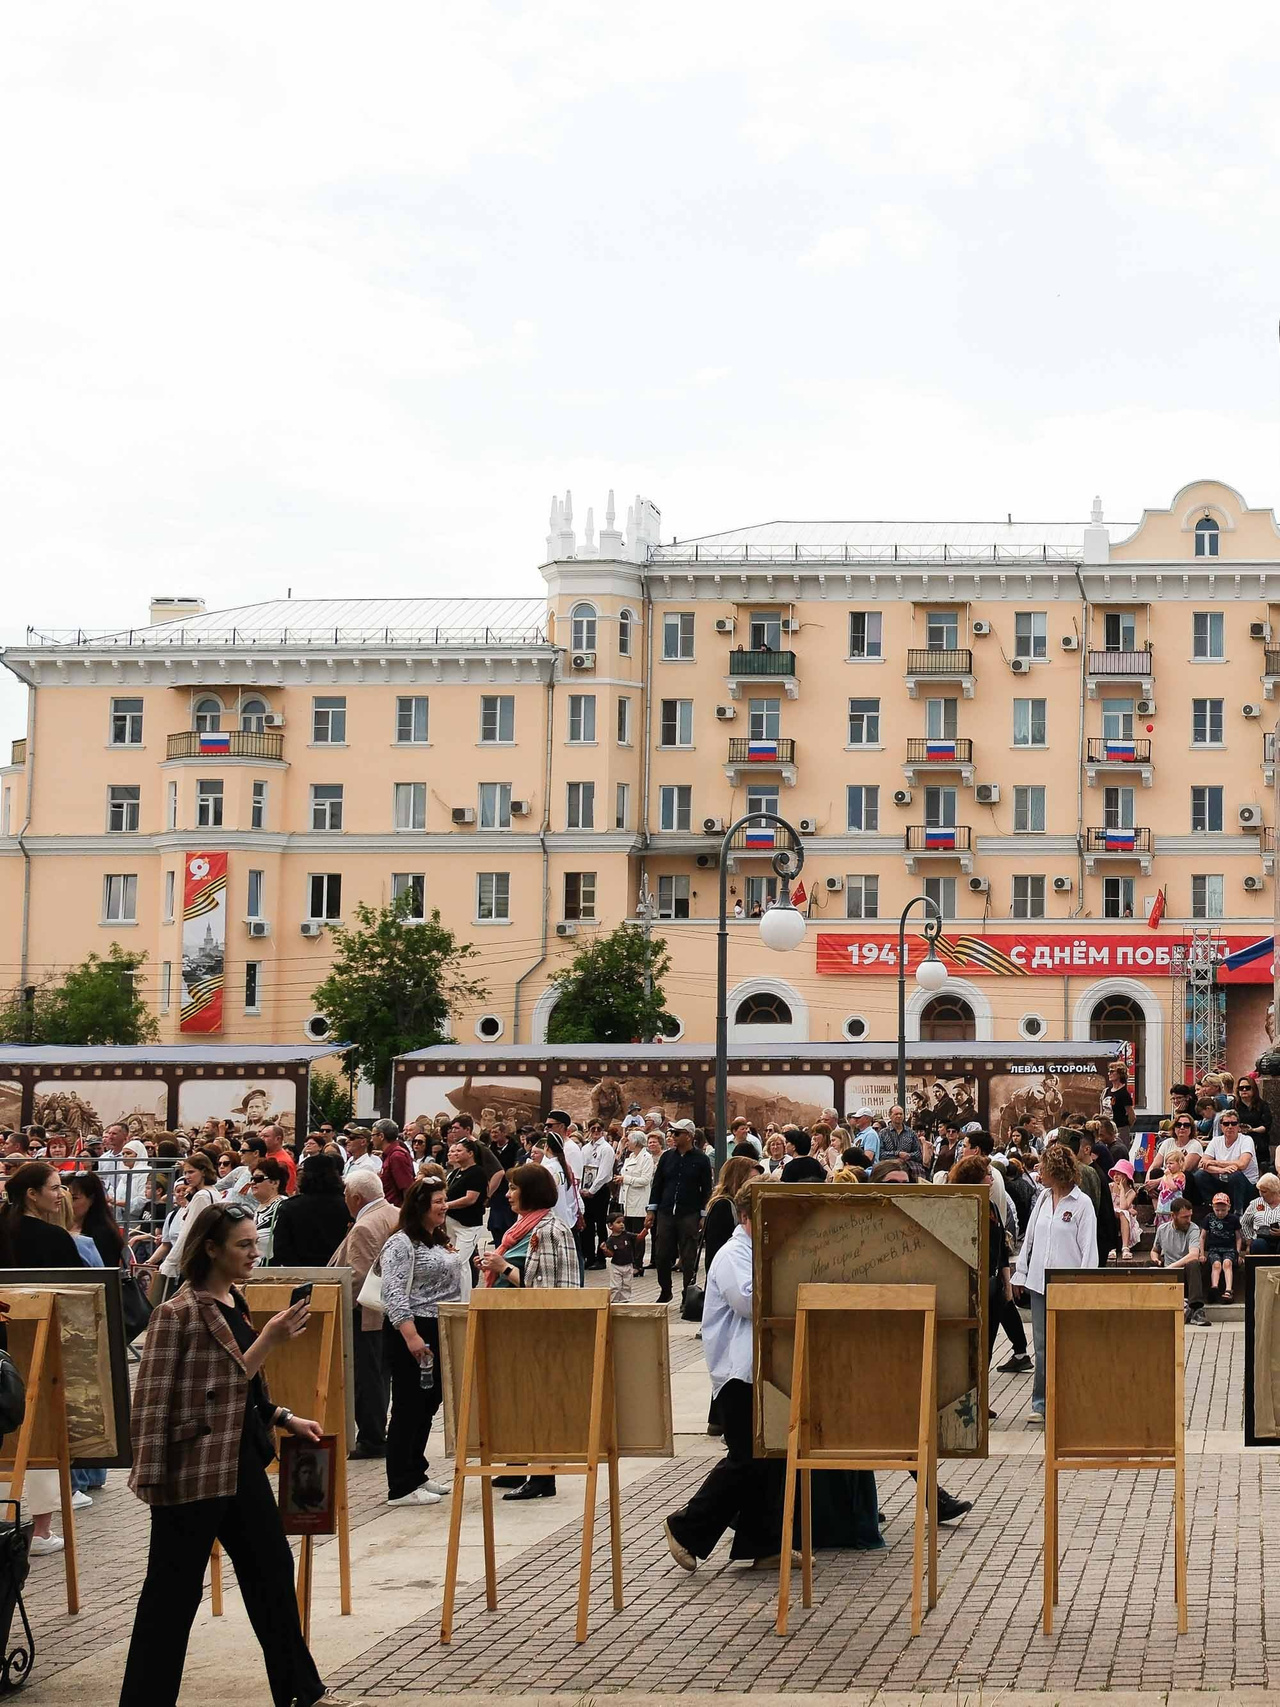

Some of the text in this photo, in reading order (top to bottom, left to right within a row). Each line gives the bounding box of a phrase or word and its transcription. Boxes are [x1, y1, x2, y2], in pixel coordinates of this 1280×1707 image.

[190, 858, 210, 880] 9
[847, 943, 908, 965] 1941
[1010, 940, 1230, 968] С ДНЁМ ПОБЫ
[1011, 1065, 1097, 1073] ЛЕВАЯ СТОРОНА
